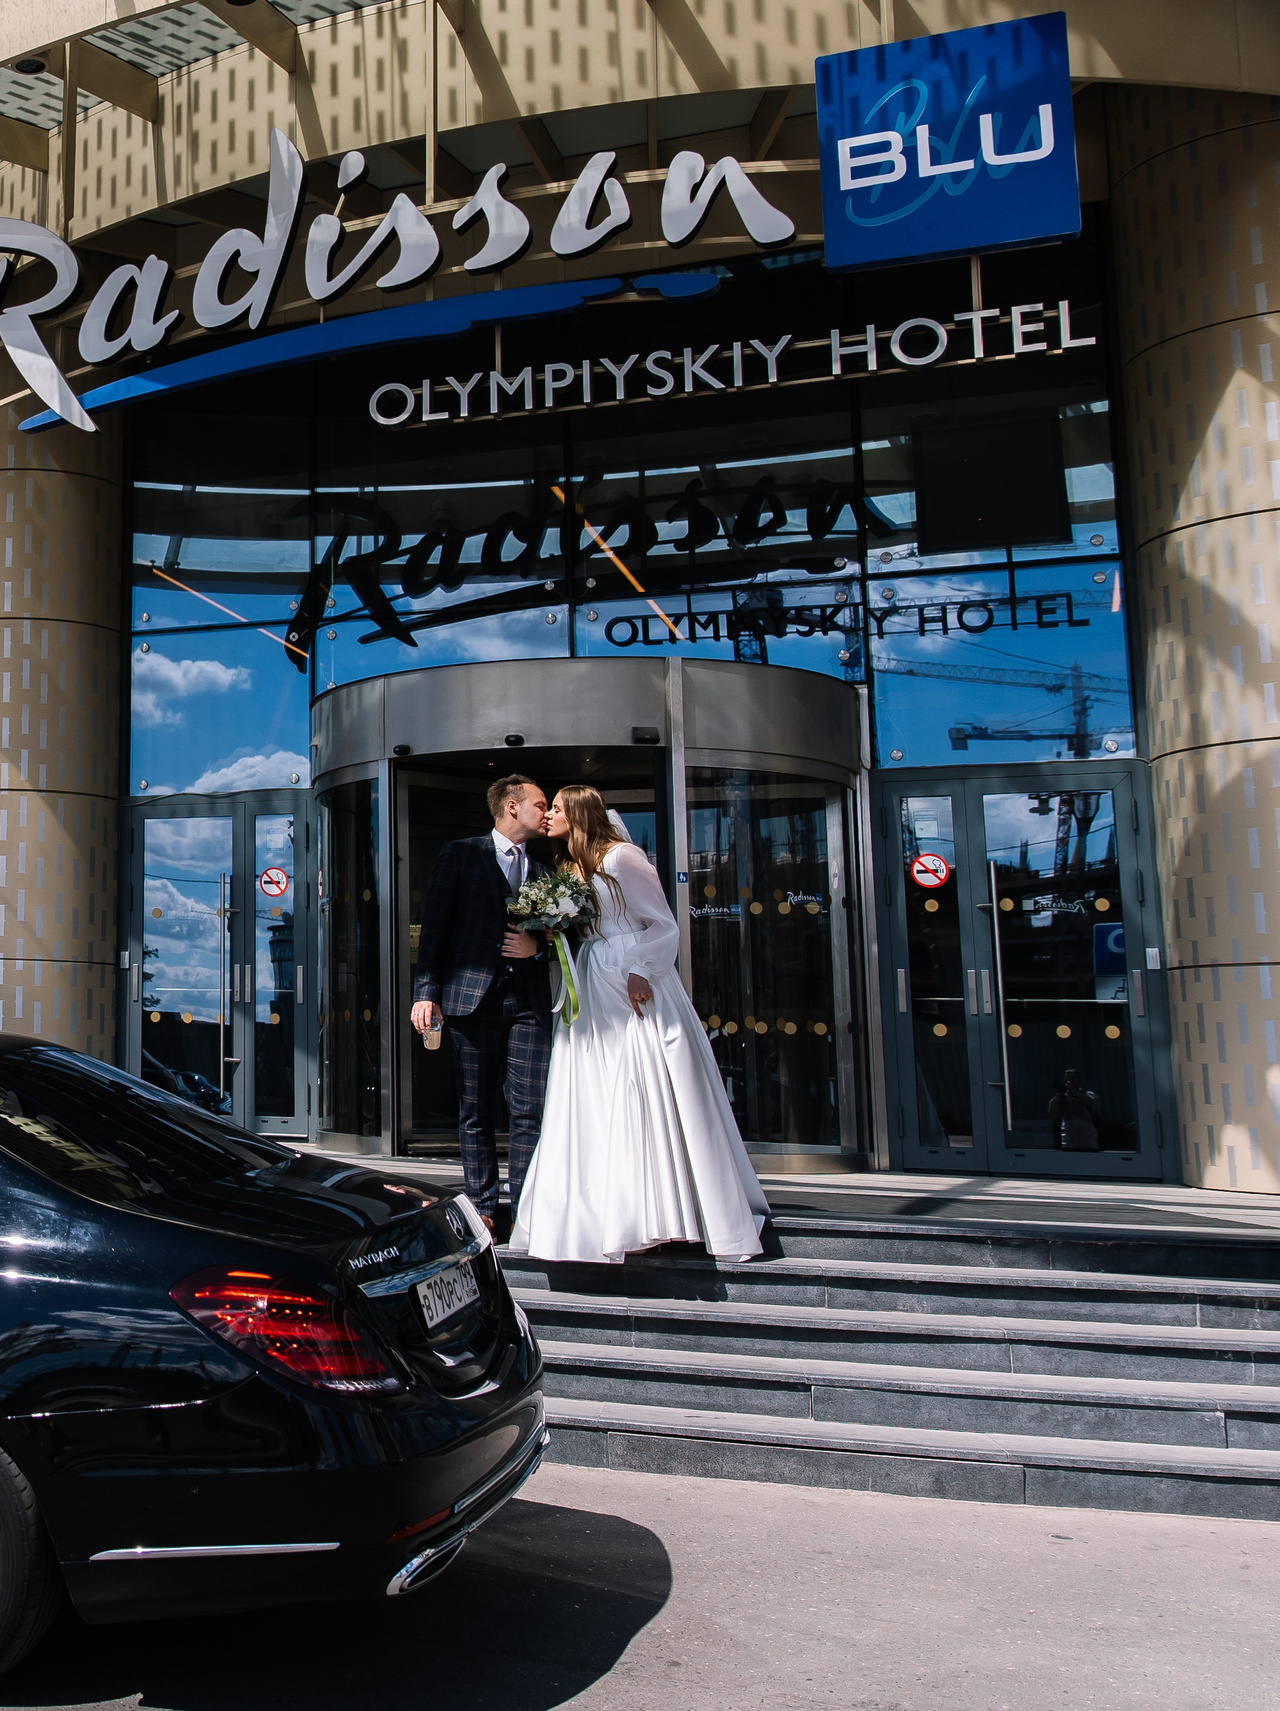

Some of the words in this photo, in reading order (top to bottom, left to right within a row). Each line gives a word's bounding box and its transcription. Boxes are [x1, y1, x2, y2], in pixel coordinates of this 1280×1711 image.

[838, 103, 1054, 191] BLU
[369, 334, 792, 426] OLYMPIYSKIY
[831, 300, 1096, 375] HOTEL
[919, 592, 1090, 637] HOTEL
[689, 903, 730, 918] Radisson
[348, 1246, 400, 1270] MAYBACH
